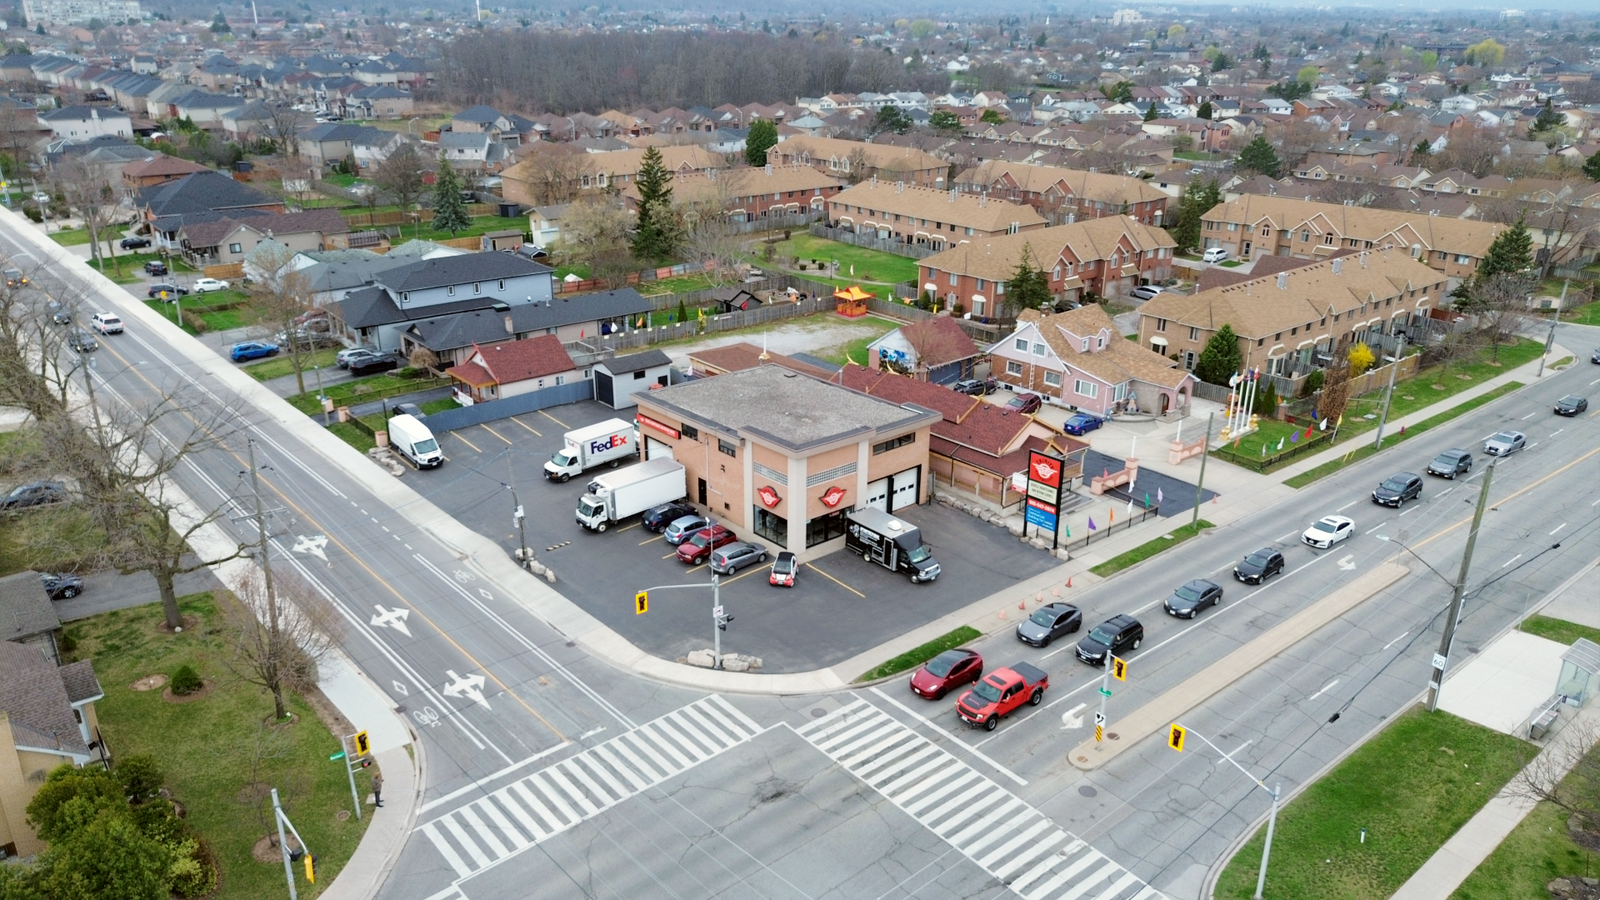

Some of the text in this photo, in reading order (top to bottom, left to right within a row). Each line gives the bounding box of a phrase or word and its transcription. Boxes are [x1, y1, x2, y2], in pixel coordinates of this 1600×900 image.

[590, 434, 627, 455] FedEx
[1036, 458, 1054, 469] TRINITY
[1434, 659, 1443, 667] 60
